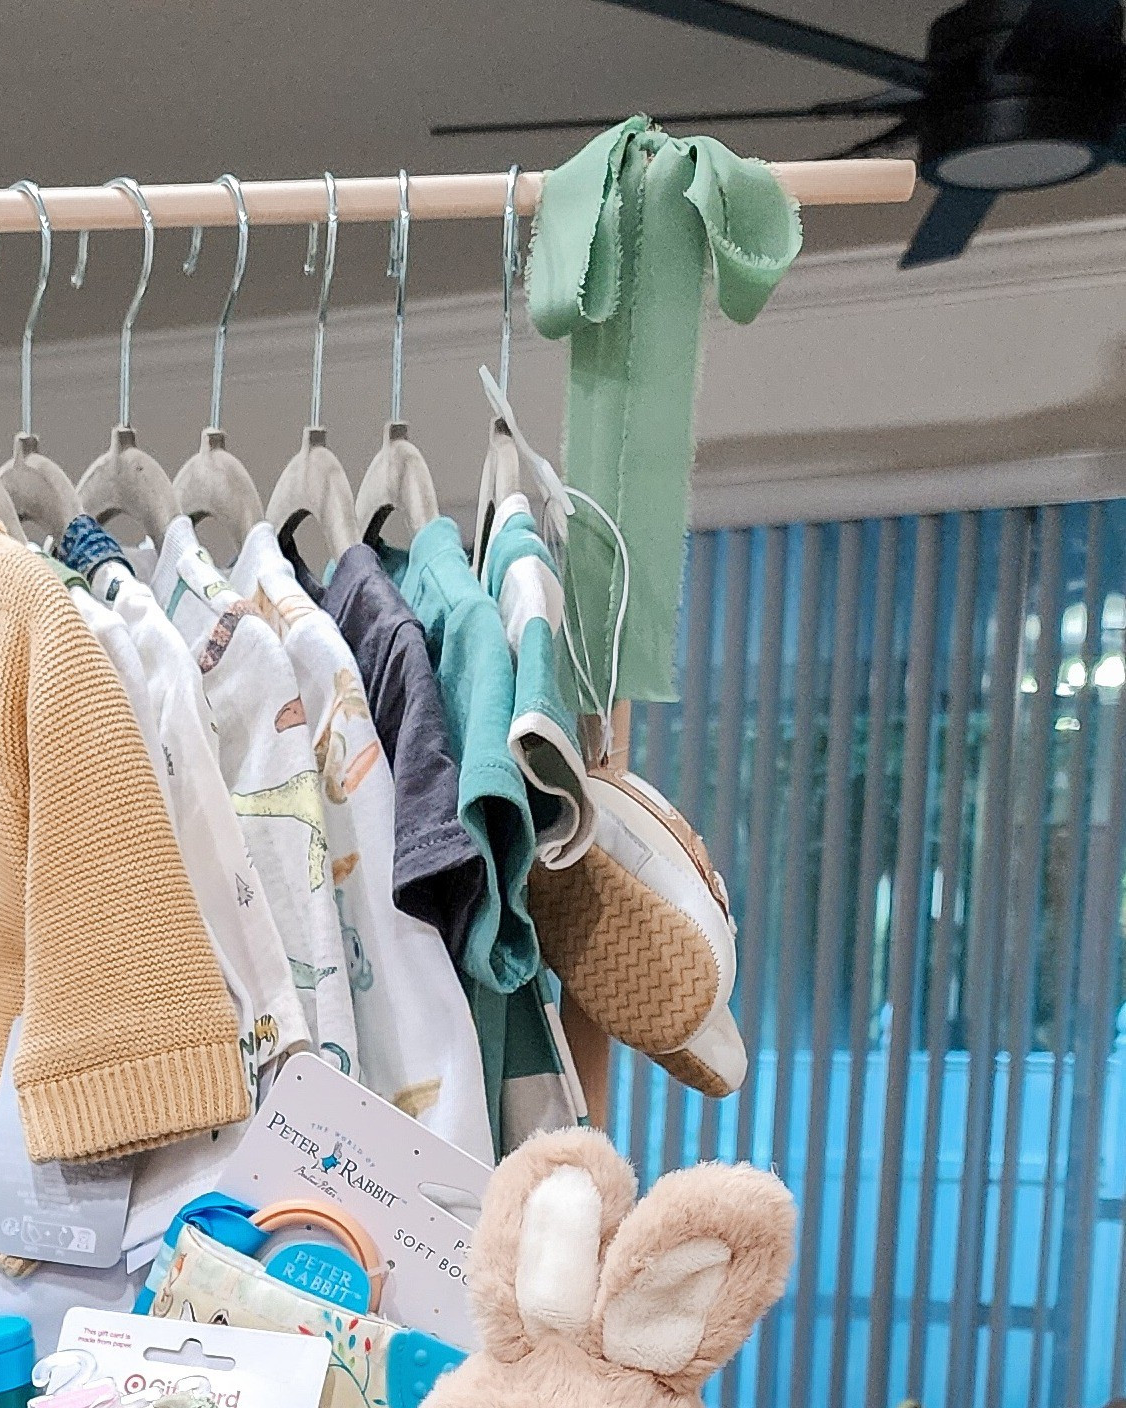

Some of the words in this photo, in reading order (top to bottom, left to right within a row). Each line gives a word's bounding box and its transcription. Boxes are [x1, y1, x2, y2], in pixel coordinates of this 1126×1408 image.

[266, 1110, 320, 1159] PETER
[393, 1228, 436, 1260] SOFT
[294, 1250, 353, 1288] PETER
